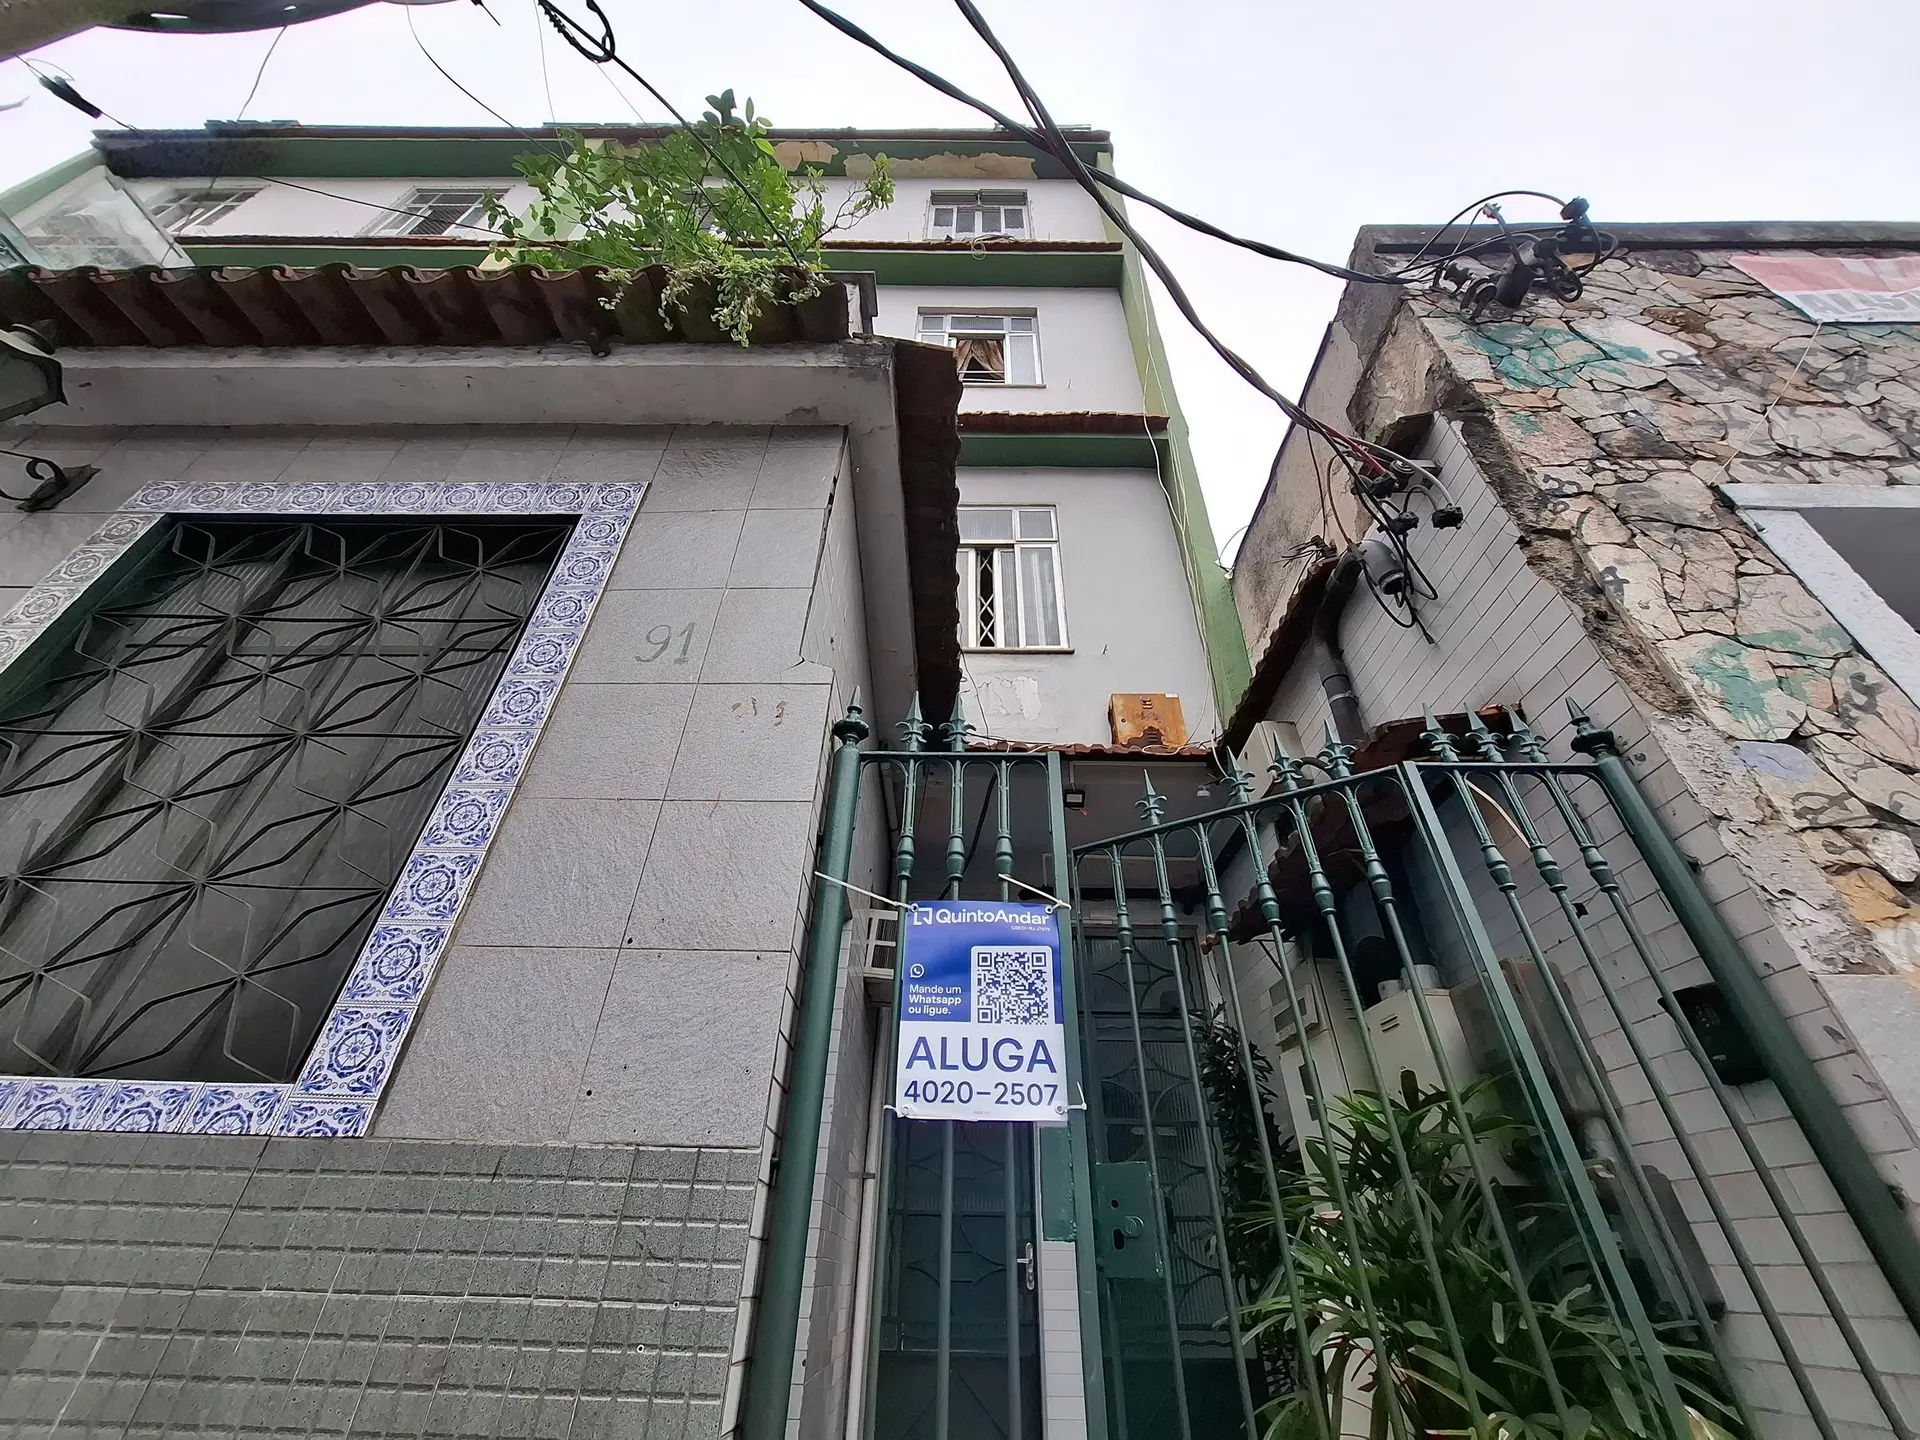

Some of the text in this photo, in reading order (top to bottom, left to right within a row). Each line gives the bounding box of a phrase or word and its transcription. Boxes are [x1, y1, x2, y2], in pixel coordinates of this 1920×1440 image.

[634, 622, 696, 664] 91
[936, 909, 1049, 925] QuintoAndar
[909, 984, 962, 994] Mande um
[908, 995, 962, 1006] Whatsapp
[923, 1005, 951, 1016] ligue.
[906, 1036, 1057, 1073] ALUGA
[904, 1080, 1058, 1107] 4020-2507
